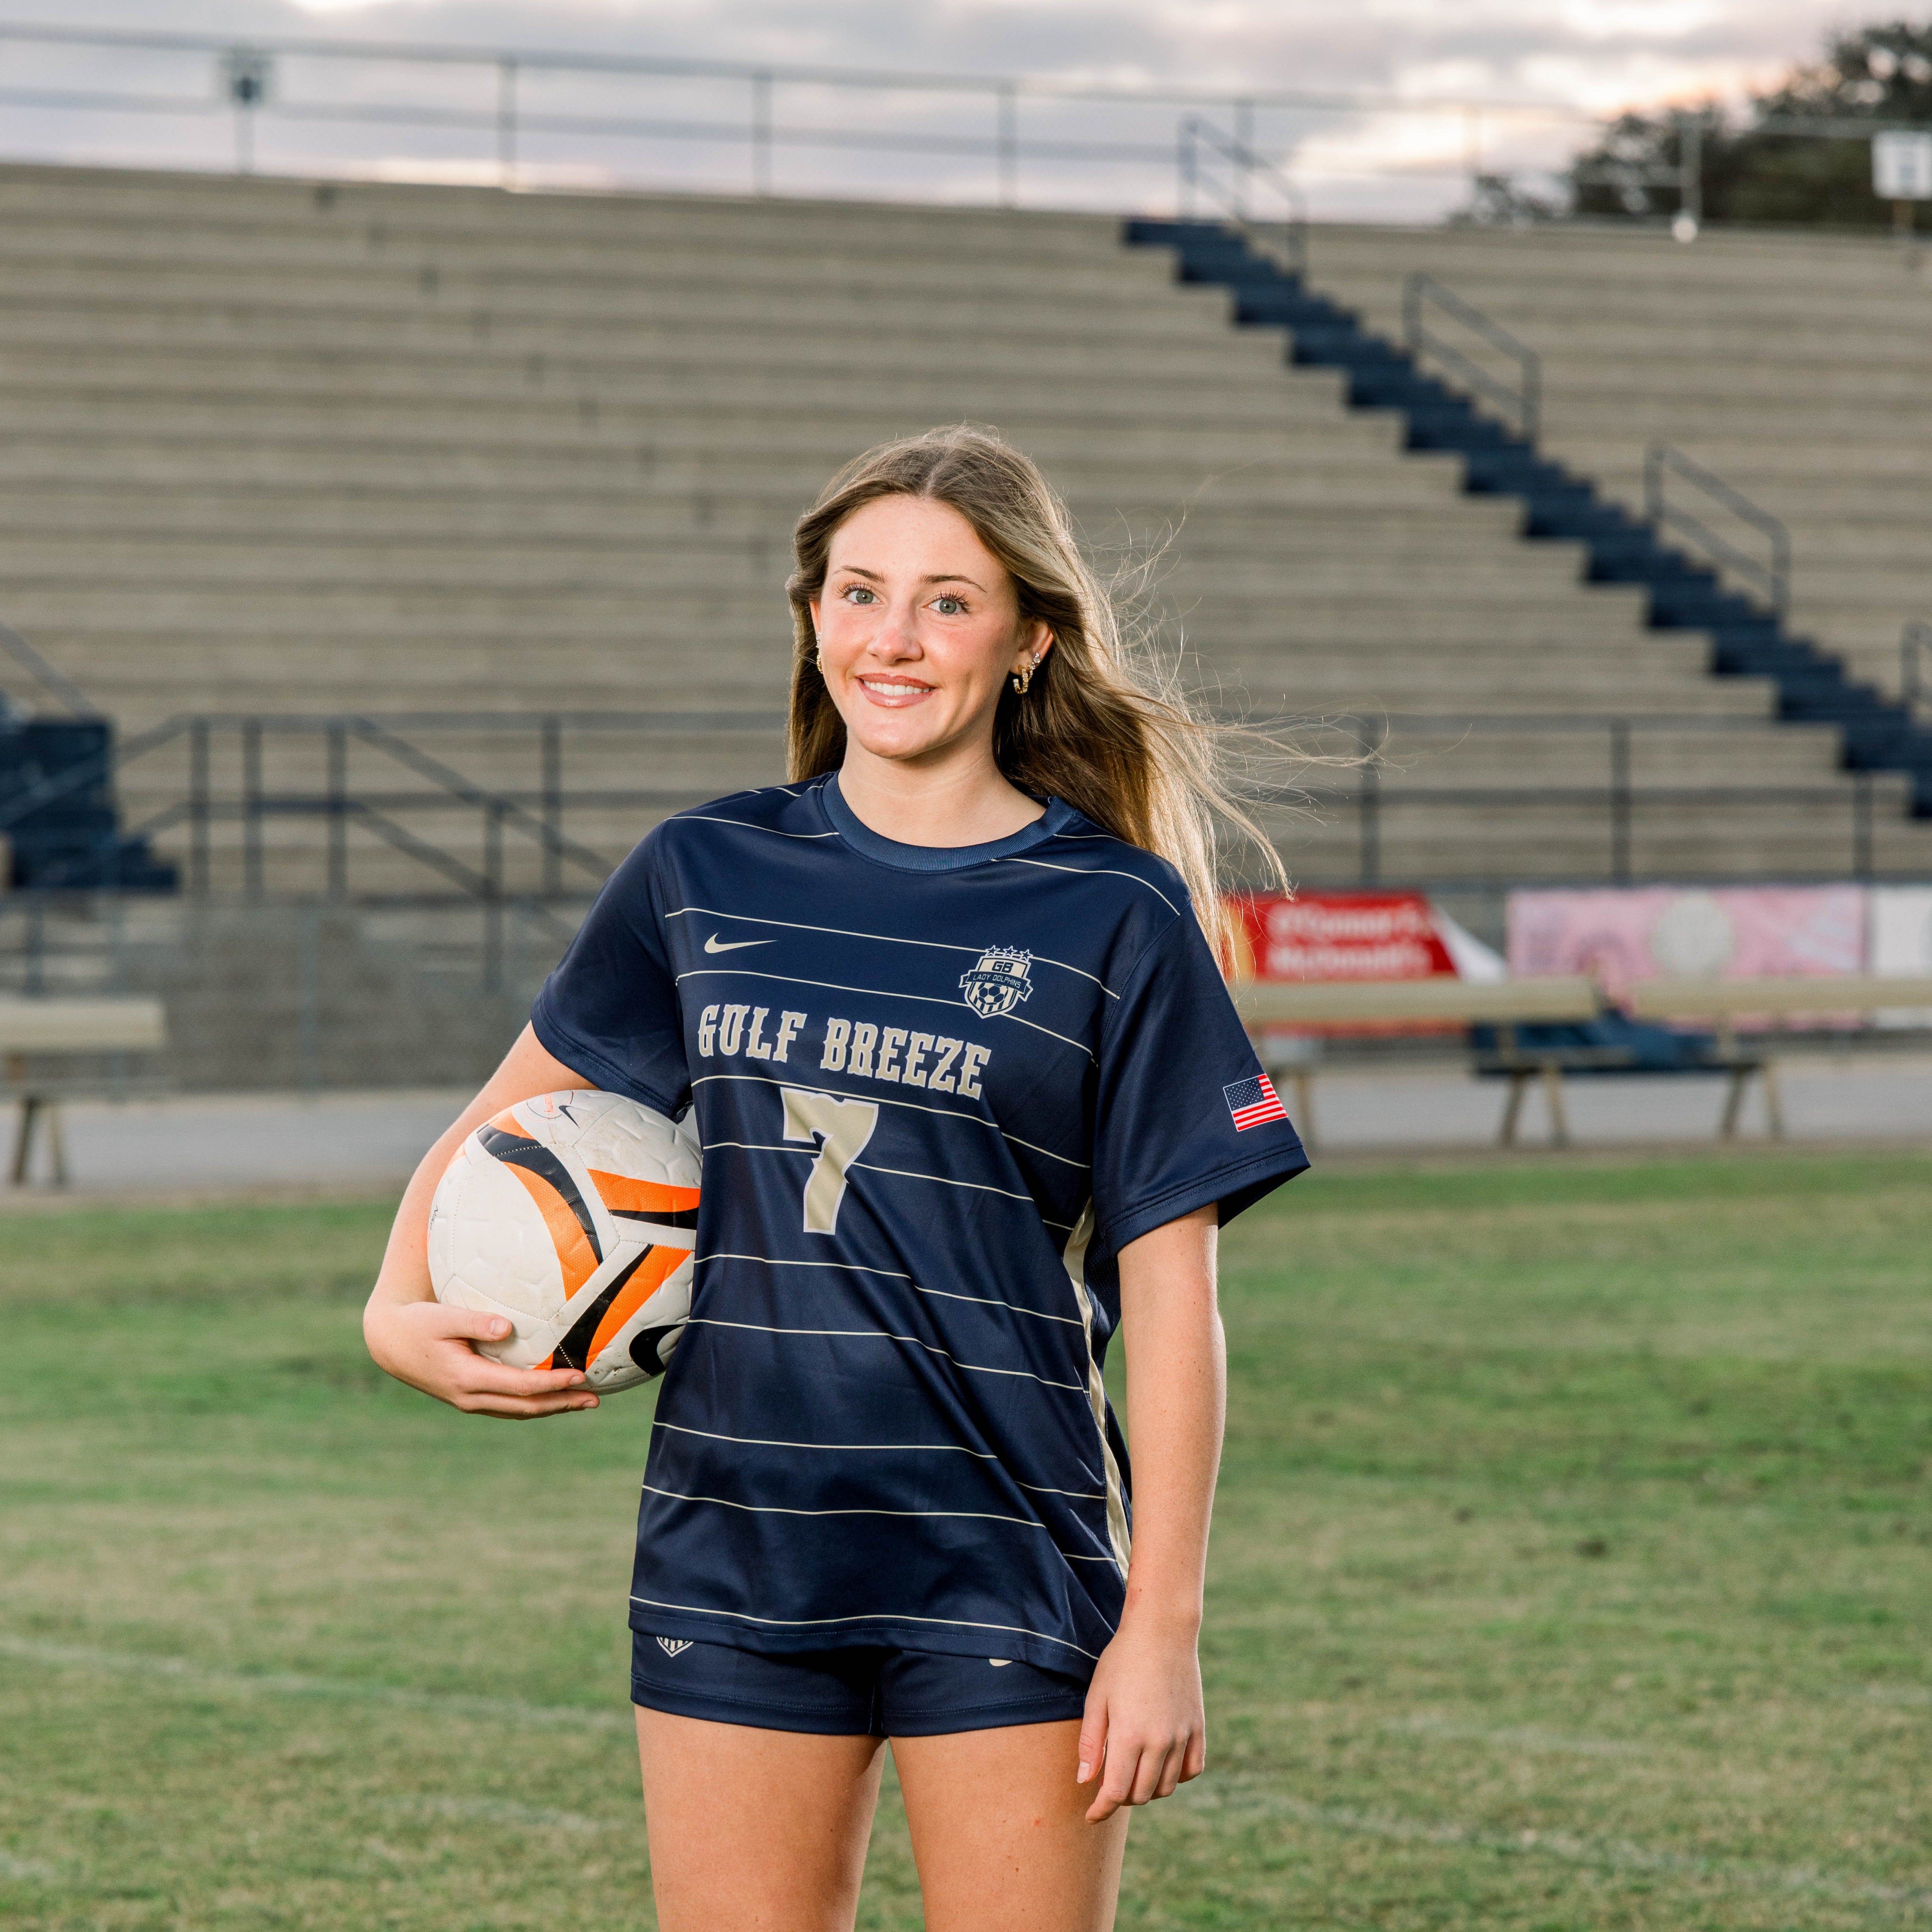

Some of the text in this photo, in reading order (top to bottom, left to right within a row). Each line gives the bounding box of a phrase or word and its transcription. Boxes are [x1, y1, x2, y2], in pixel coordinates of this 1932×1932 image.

[992, 961, 1014, 973] GB
[992, 974, 1021, 989] DOLPHINS
[698, 1004, 992, 1101] GULF BREEZE
[780, 1087, 879, 1235] 7
